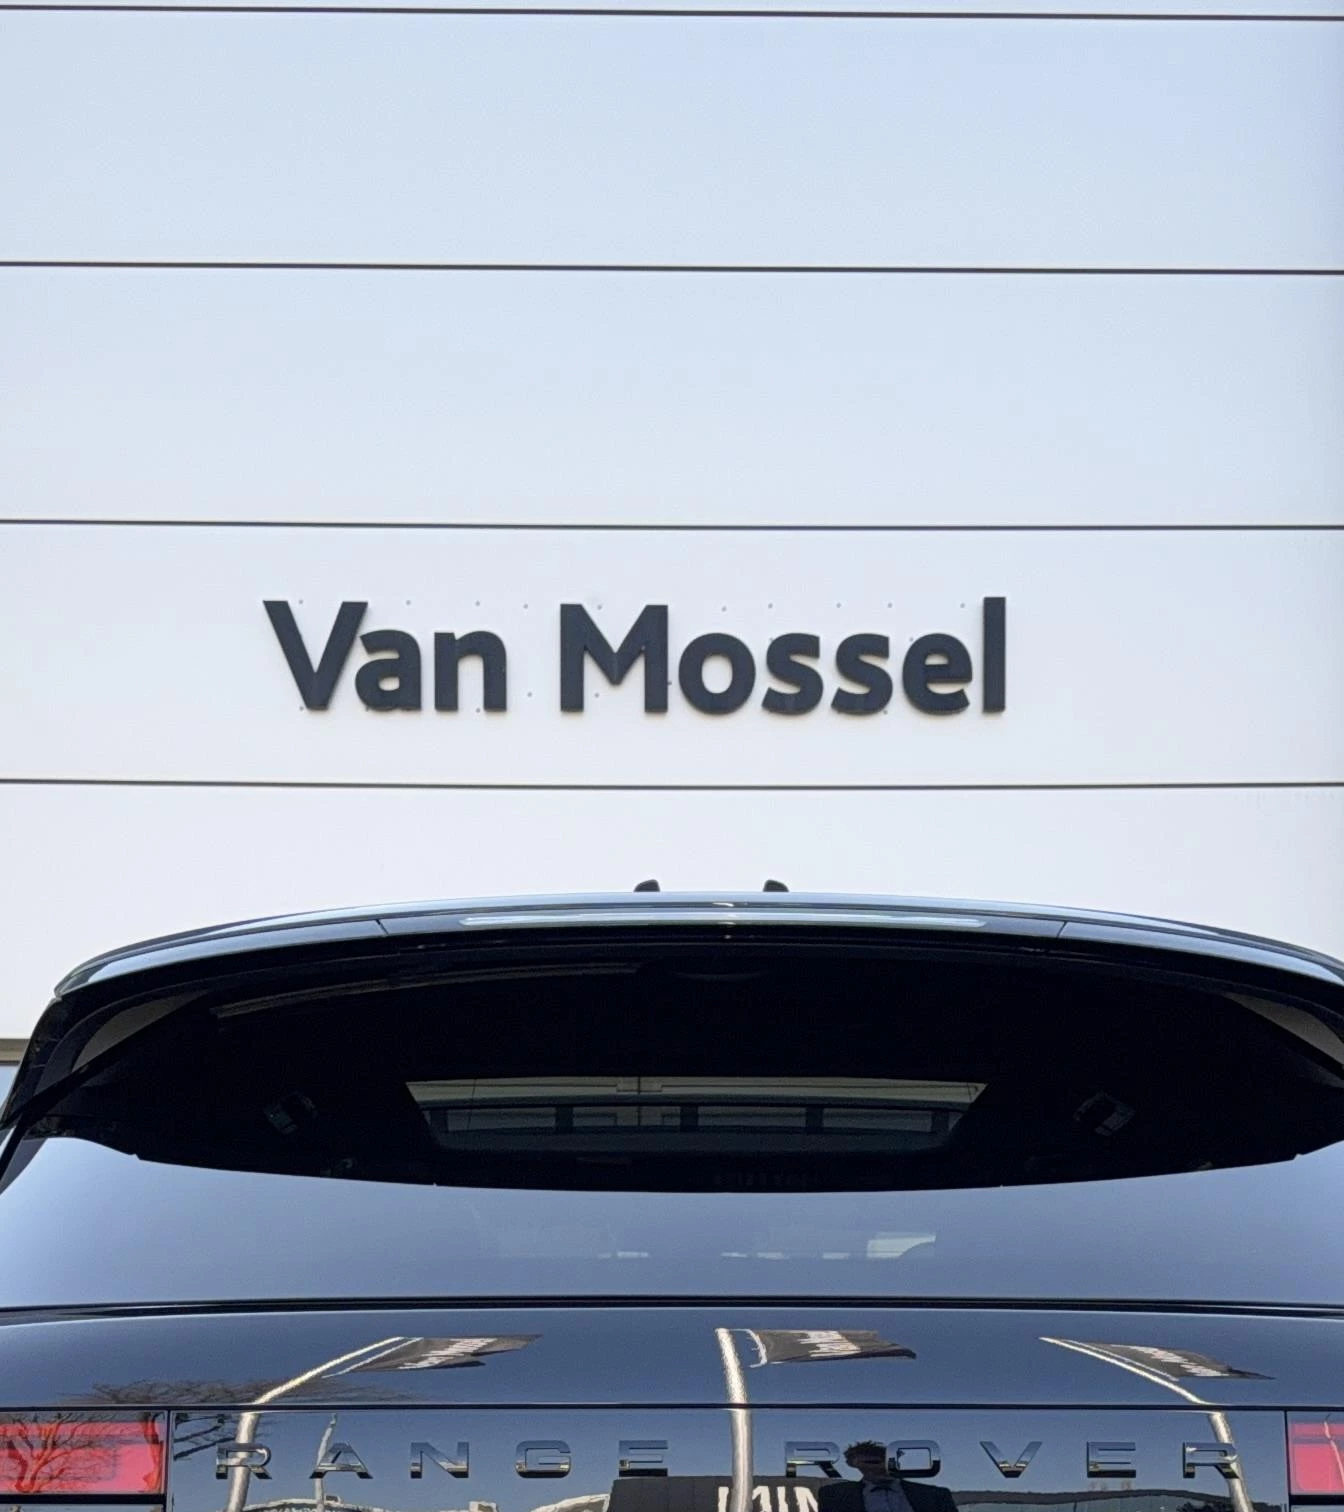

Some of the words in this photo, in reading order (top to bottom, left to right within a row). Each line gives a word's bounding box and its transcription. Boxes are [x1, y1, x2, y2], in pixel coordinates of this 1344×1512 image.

[262, 600, 507, 713] Van
[559, 596, 1006, 717] Mossel
[215, 1439, 669, 1479] RANGE
[784, 1440, 1241, 1479] ROVER
